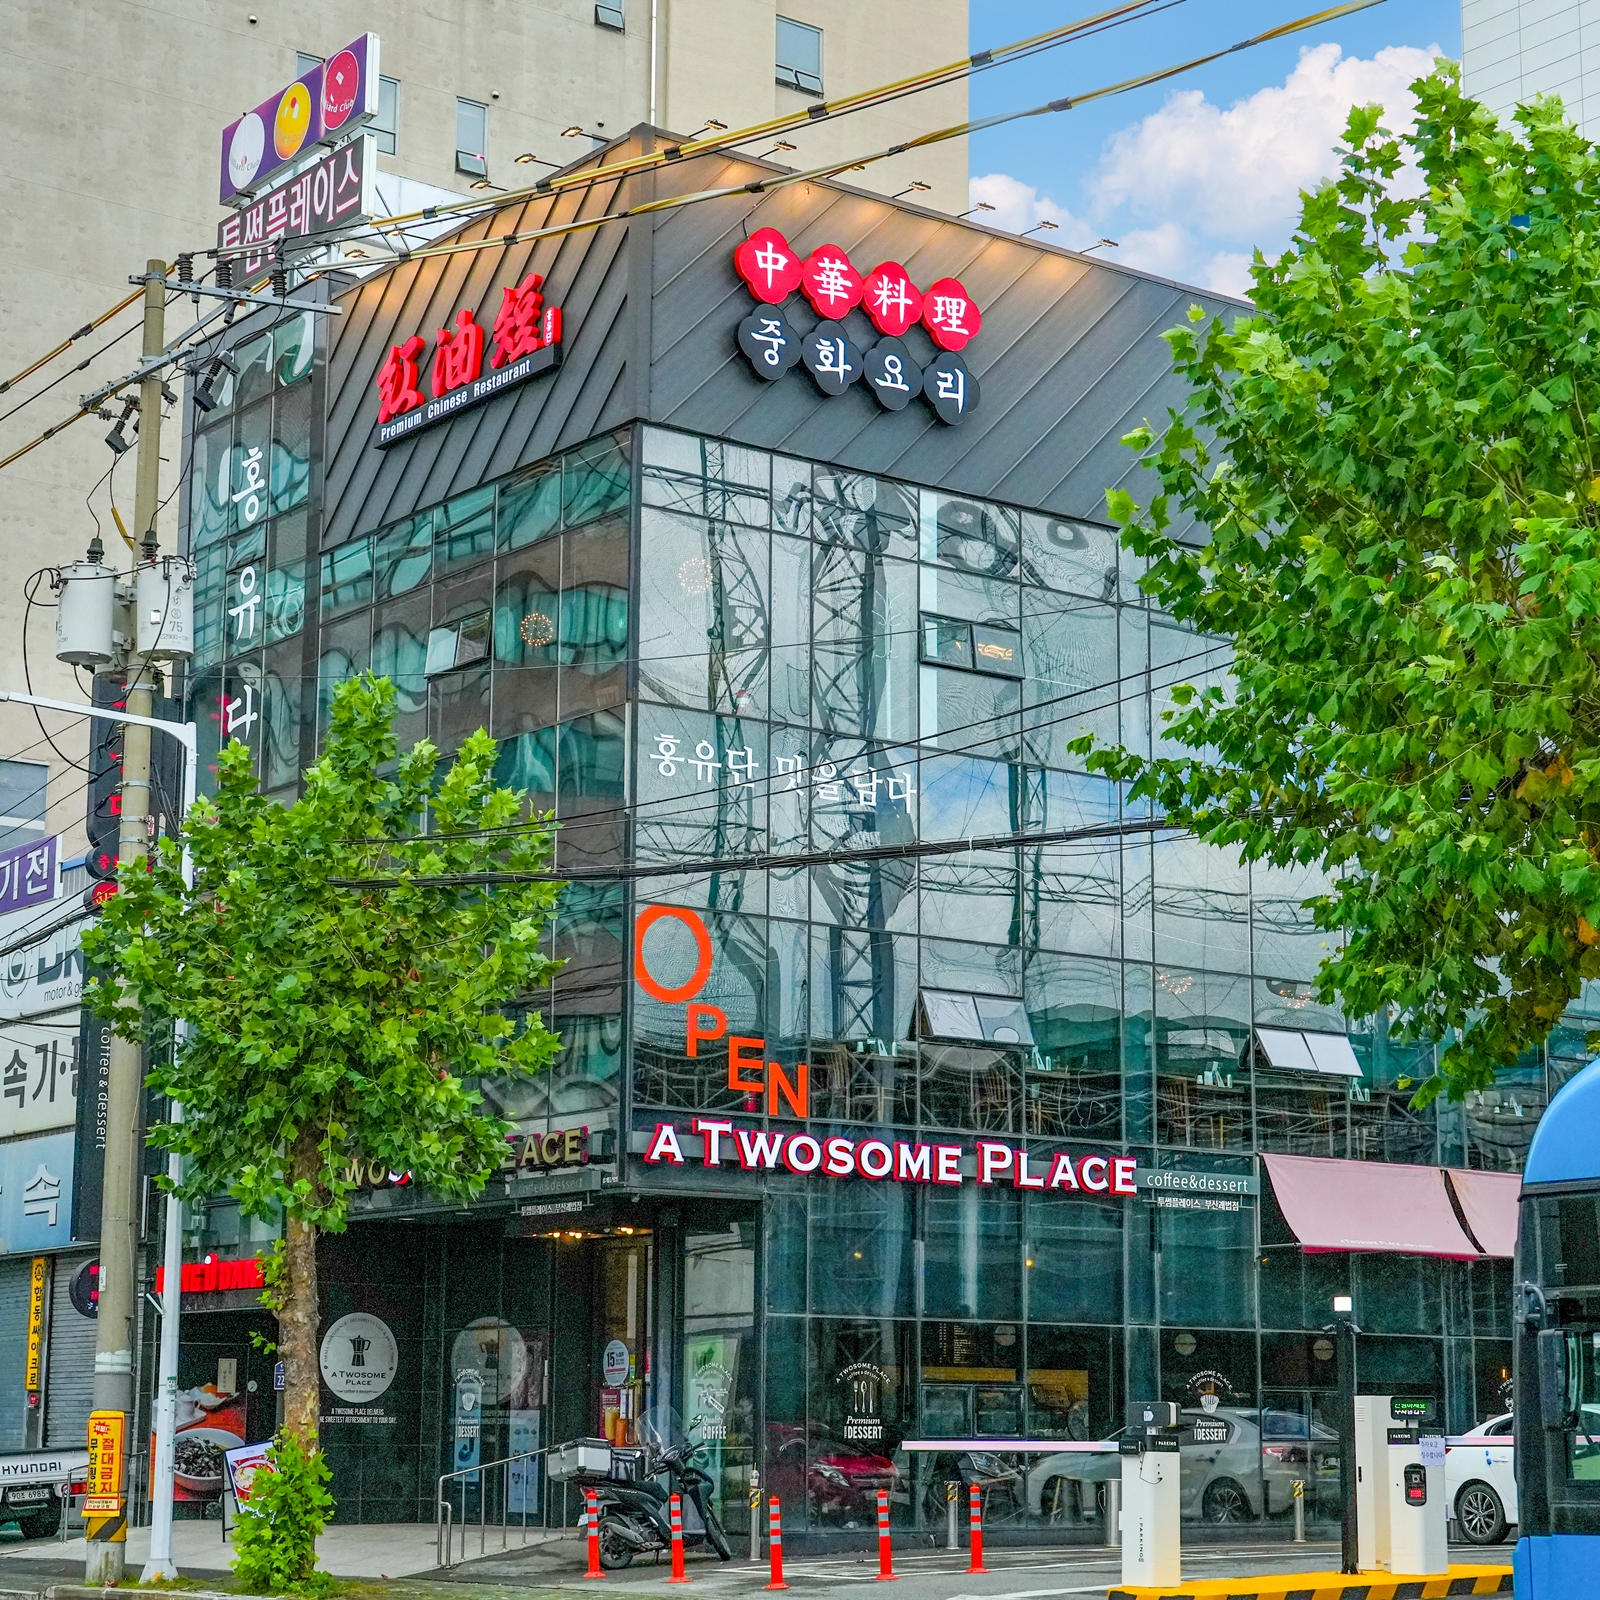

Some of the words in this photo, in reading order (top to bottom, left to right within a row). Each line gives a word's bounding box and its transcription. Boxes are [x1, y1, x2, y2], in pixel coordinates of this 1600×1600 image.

[754, 241, 970, 336] 中華料理
[751, 318, 965, 414] 중화요리
[381, 412, 422, 441] Premium
[428, 391, 468, 419] Chinese
[474, 359, 531, 398] Restaurant
[169, 621, 183, 633] 75
[649, 734, 759, 788] 홍유단
[44, 984, 67, 1002] motor
[634, 905, 808, 1117] OPEN
[99, 1026, 111, 1075] coffee
[98, 1079, 108, 1088] &
[95, 1091, 109, 1150] dessert
[645, 1123, 684, 1164] A
[694, 1118, 962, 1185] TWOSOME
[979, 1141, 1137, 1195] PLACE
[1147, 1172, 1248, 1192] coffee&dessert
[607, 1352, 615, 1367] 15
[339, 1371, 386, 1379] TWOSOME
[839, 1362, 872, 1378] TWOSOME
[872, 1365, 891, 1385] PLACE
[1188, 1370, 1216, 1385] TWOSOME
[1216, 1372, 1233, 1392] PLACE
[355, 1408, 366, 1416] PLACE
[846, 1415, 881, 1425] Premium
[1195, 1418, 1225, 1427] Premium
[702, 1425, 727, 1440] COFFEE
[847, 1425, 883, 1439] DESSERT
[1196, 1428, 1227, 1441] DESSERT
[2, 1461, 61, 1476] HYUNDAI
[101, 1438, 115, 1493] 절대금지
[28, 1490, 46, 1499] 6985
